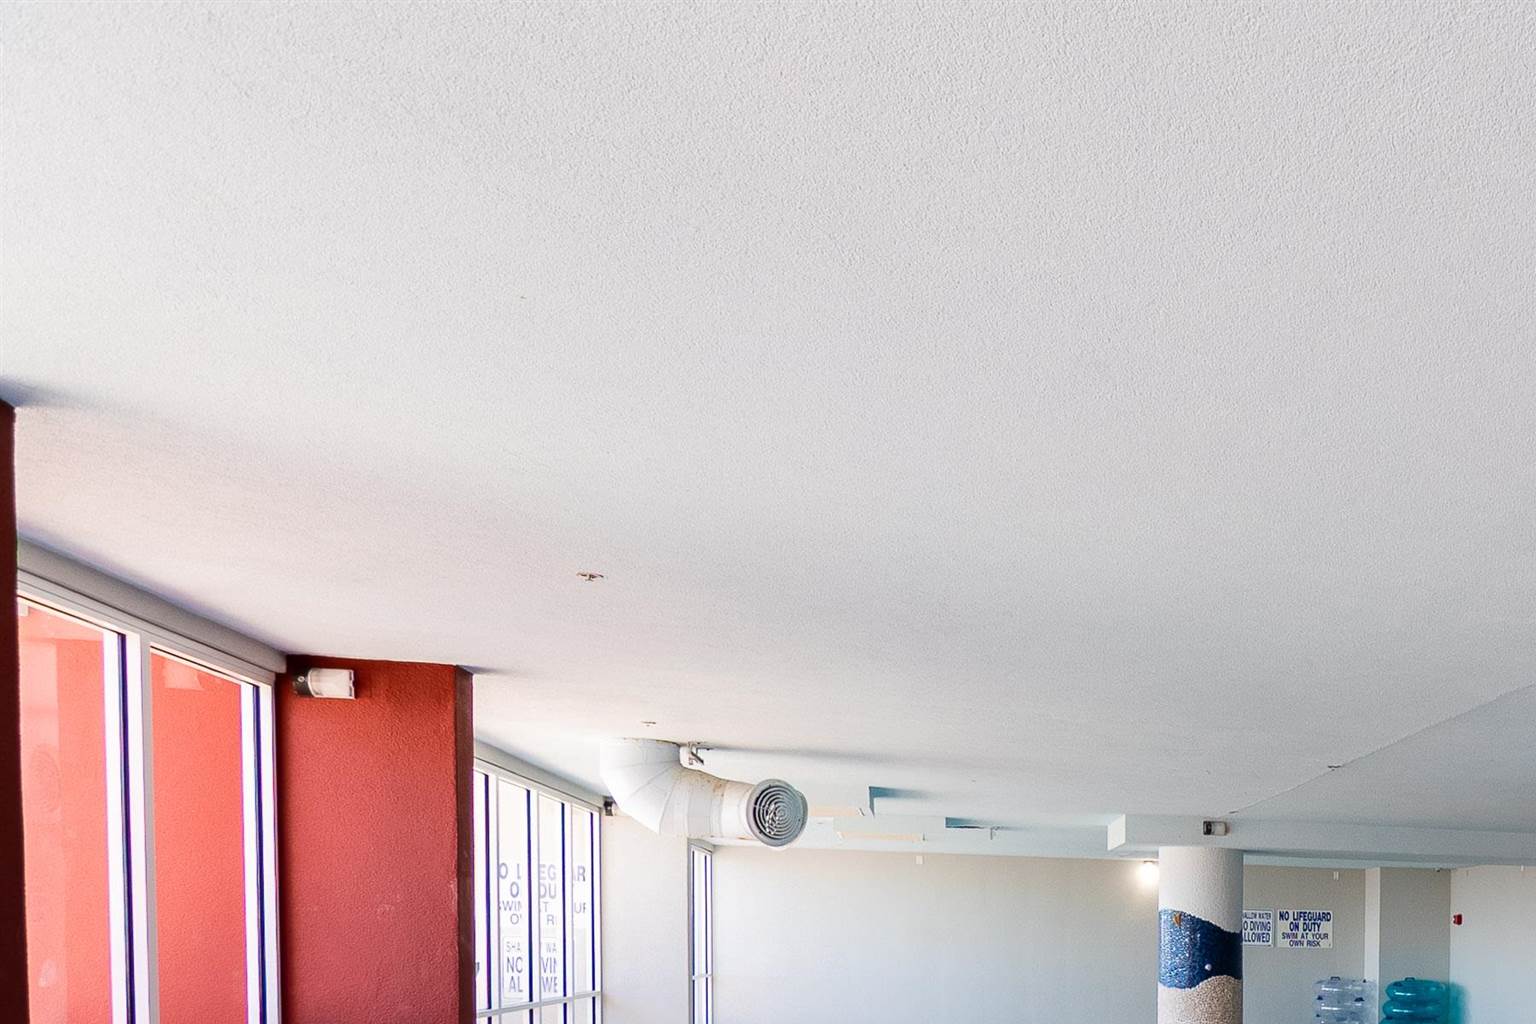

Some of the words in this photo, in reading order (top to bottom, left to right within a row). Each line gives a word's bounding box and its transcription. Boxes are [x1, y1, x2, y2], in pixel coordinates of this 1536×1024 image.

[1279, 911, 1289, 920] NO
[1293, 911, 1331, 922] LIFEGUARD
[1250, 921, 1271, 932] DIVING
[1289, 921, 1299, 932] ON
[1303, 922, 1321, 932] DUTY
[1244, 932, 1270, 943] LLOWED
[1282, 932, 1297, 940] SWIM
